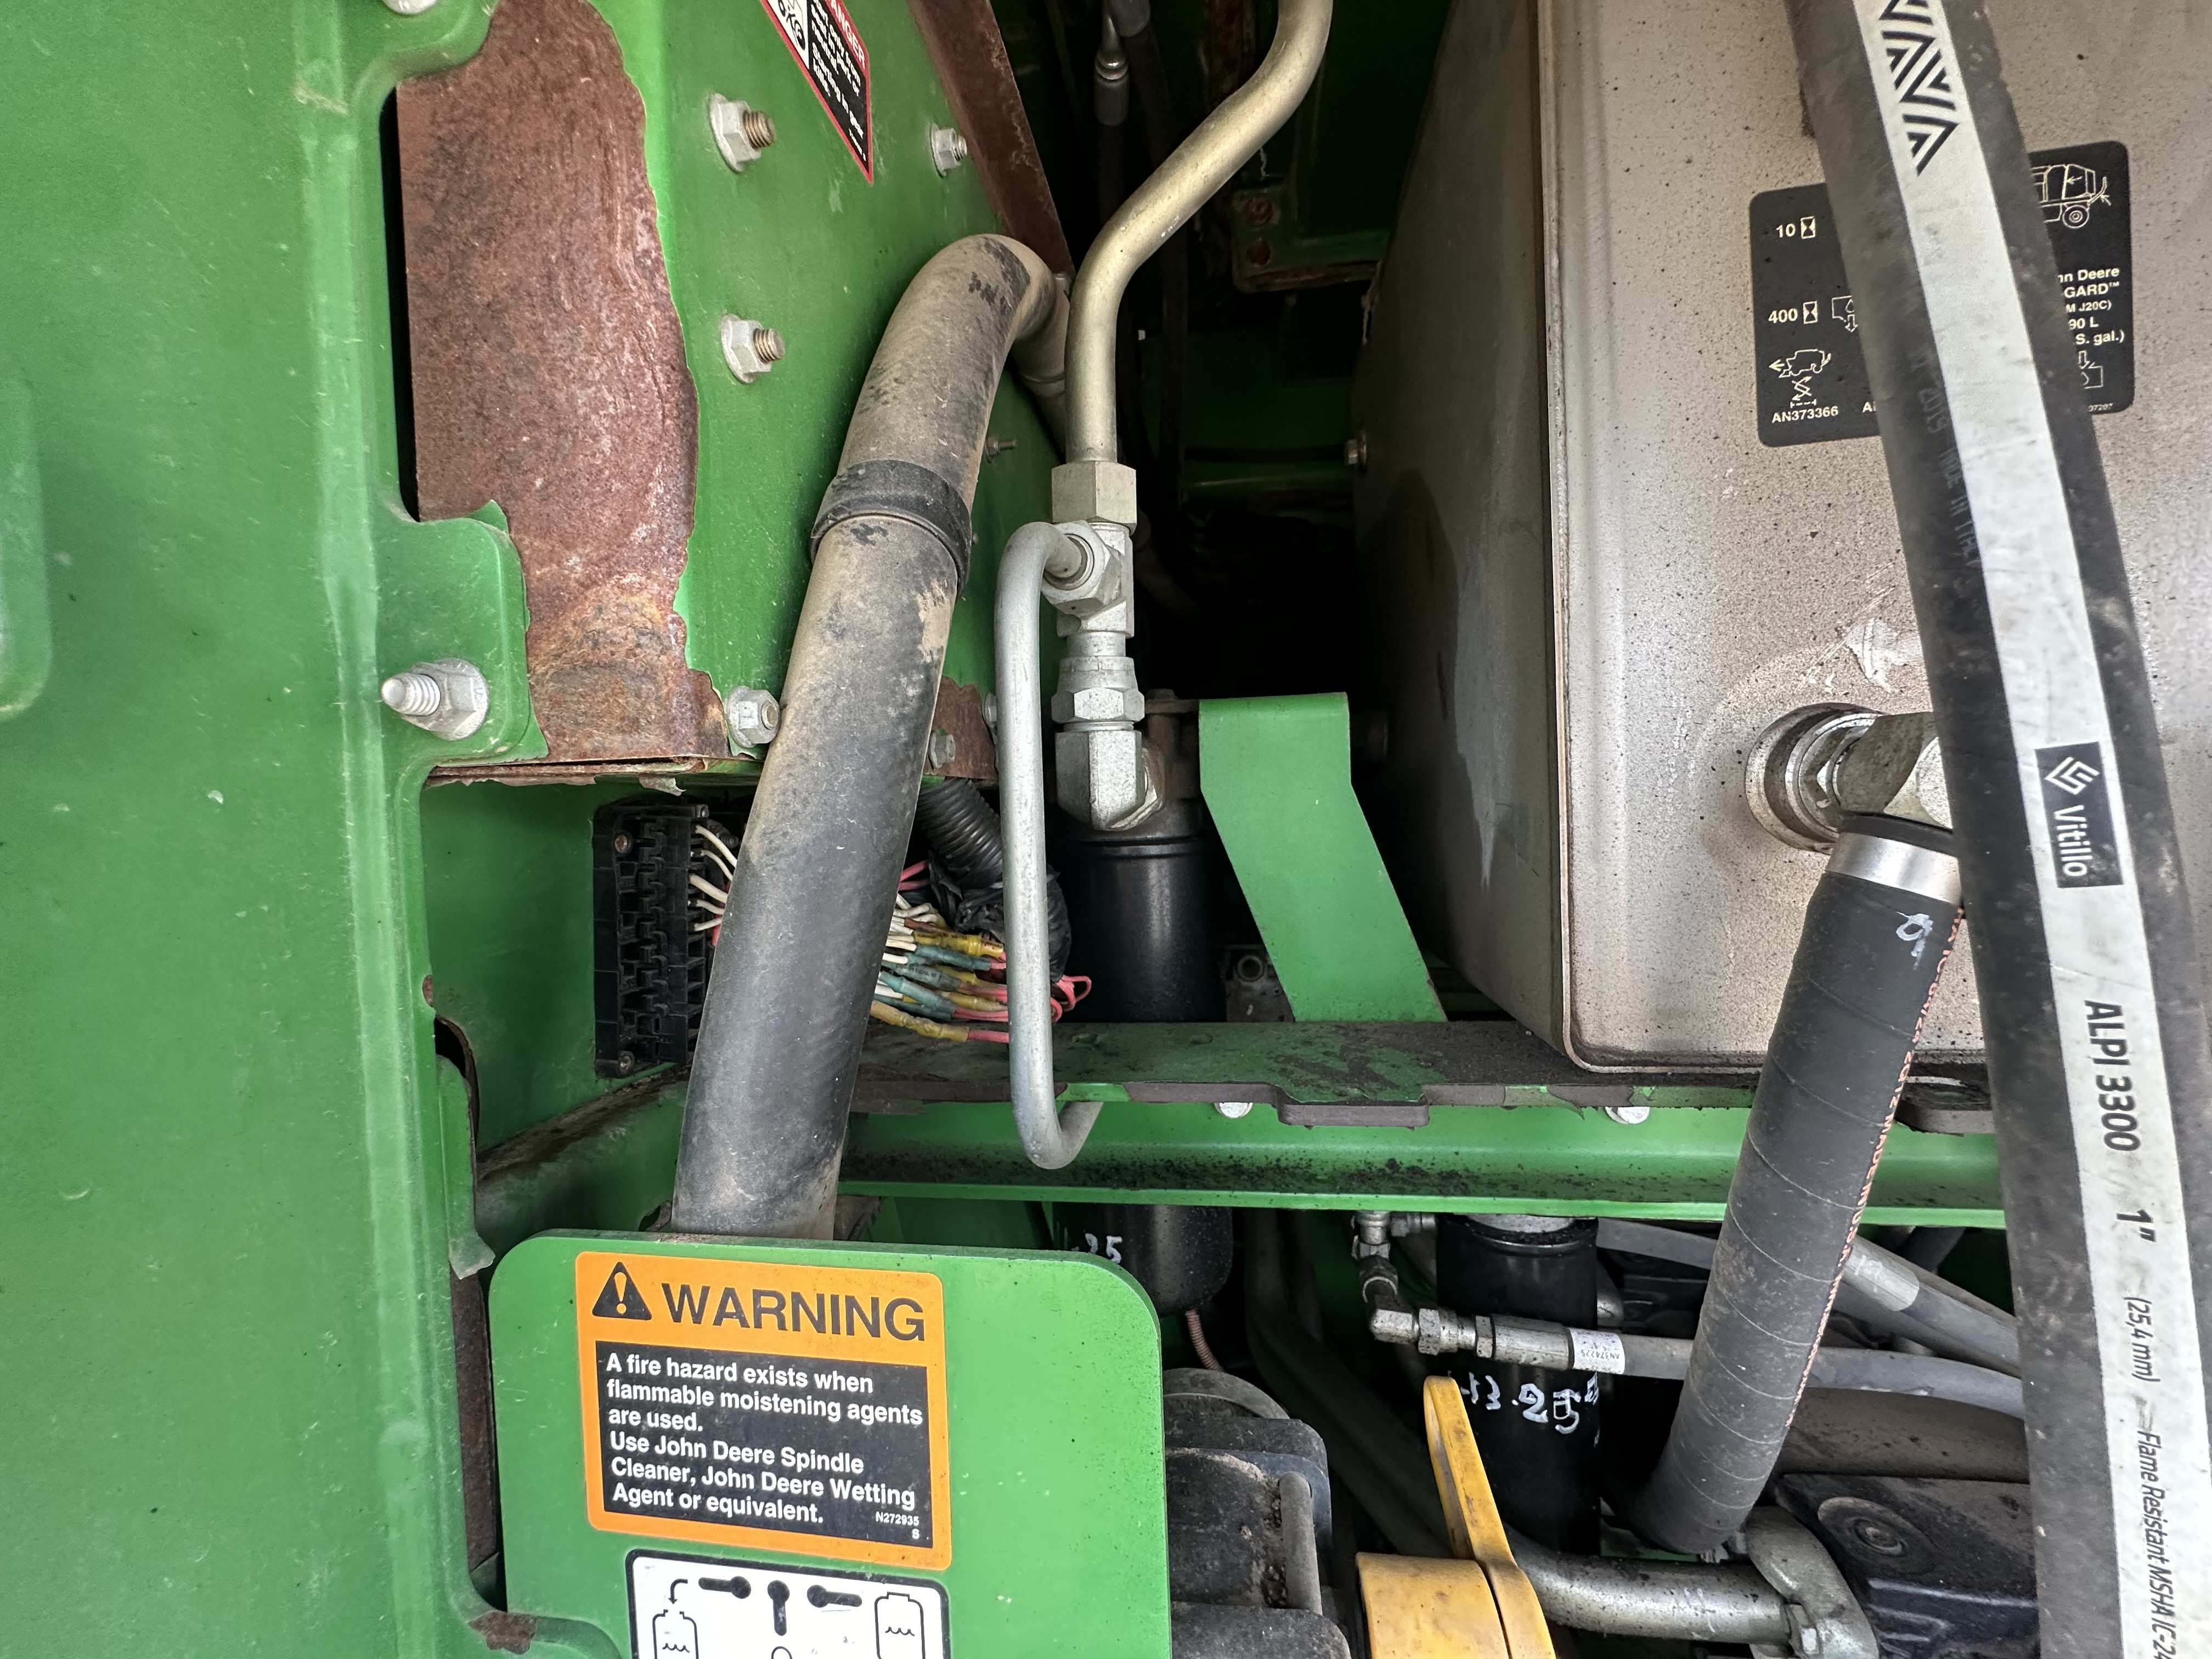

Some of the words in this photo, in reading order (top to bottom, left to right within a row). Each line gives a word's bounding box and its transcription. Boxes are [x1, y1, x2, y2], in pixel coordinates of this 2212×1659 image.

[828, 32, 836, 54] in
[830, 0, 865, 70] ANGER
[830, 24, 845, 58] only
[812, 42, 840, 103] Starting
[1776, 224, 1796, 238] 10
[2064, 281, 2120, 298] GARD™
[2078, 268, 2120, 281] Deere
[1768, 309, 1798, 324] 400
[2079, 300, 2112, 312] J20C)
[2090, 317, 2099, 328] L
[2075, 333, 2090, 345] S.
[2094, 330, 2125, 346] gal.)
[1771, 406, 1838, 424] AN373366
[2053, 804, 2092, 878] Vitillo
[2085, 1000, 2130, 1066] ALPI
[2097, 1076, 2141, 1152] 3300
[662, 1282, 926, 1341] WARNING
[606, 1352, 622, 1372] A
[627, 1354, 661, 1375] fire
[667, 1357, 737, 1382] hazard
[743, 1365, 808, 1387] exists
[814, 1370, 873, 1393] when
[607, 1379, 714, 1407] flammable
[720, 1391, 840, 1423] moistening
[847, 1403, 923, 1425] agents
[608, 1408, 641, 1426] are
[647, 1412, 703, 1432] used.
[610, 1430, 650, 1453] Use
[654, 1435, 707, 1458] John
[713, 1440, 775, 1465] Deere
[781, 1447, 864, 1474] Spindle
[2138, 1430, 2162, 1485] Flame
[611, 1457, 696, 1487] Cleaner,
[701, 1466, 755, 1489] John
[761, 1471, 824, 1497] Deere
[830, 1478, 915, 1511] Wetting
[613, 1482, 674, 1508] Agent
[679, 1493, 701, 1509] or
[707, 1496, 823, 1523] equivalent.
[876, 1511, 919, 1526] N272935
[912, 1529, 920, 1539] S
[2141, 1483, 2170, 1564] Resistant
[2147, 1564, 2176, 1617] MSHA
